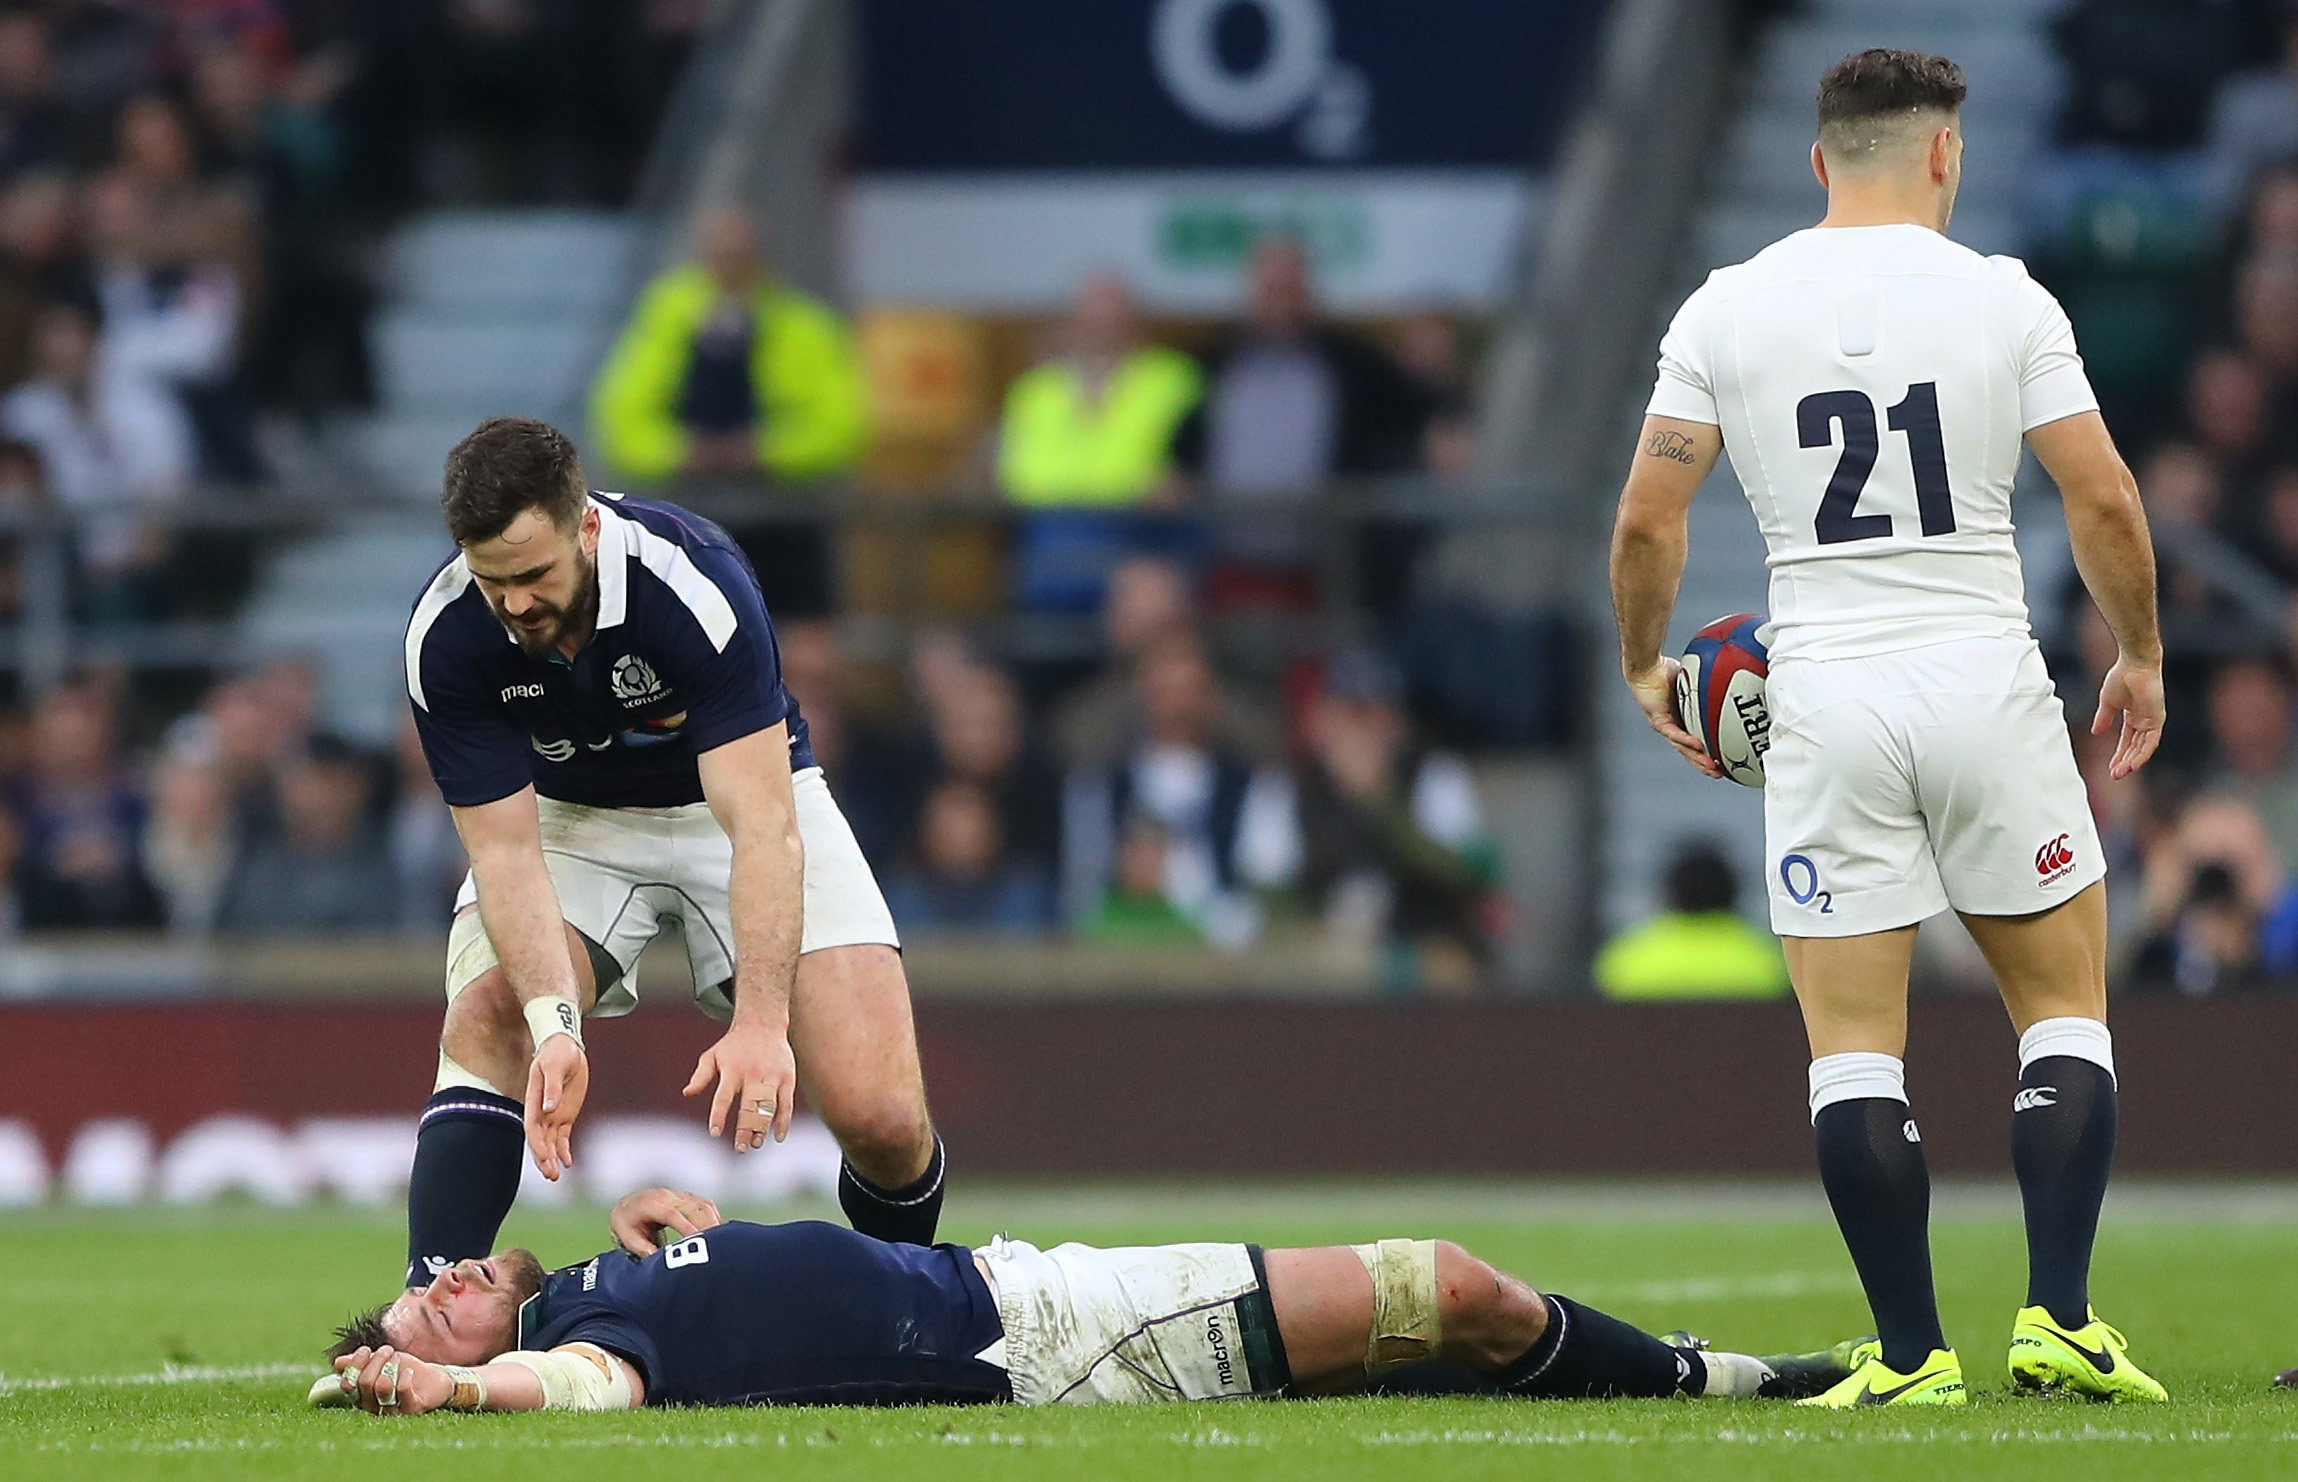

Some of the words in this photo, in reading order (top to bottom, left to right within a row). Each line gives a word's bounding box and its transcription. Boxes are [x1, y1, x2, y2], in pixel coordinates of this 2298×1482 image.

[1644, 431, 1695, 465] Blake
[1796, 381, 1957, 545] 21
[1733, 693, 1772, 774] ERT
[1780, 854, 1834, 913] O2
[1207, 1315, 1234, 1386] macron
